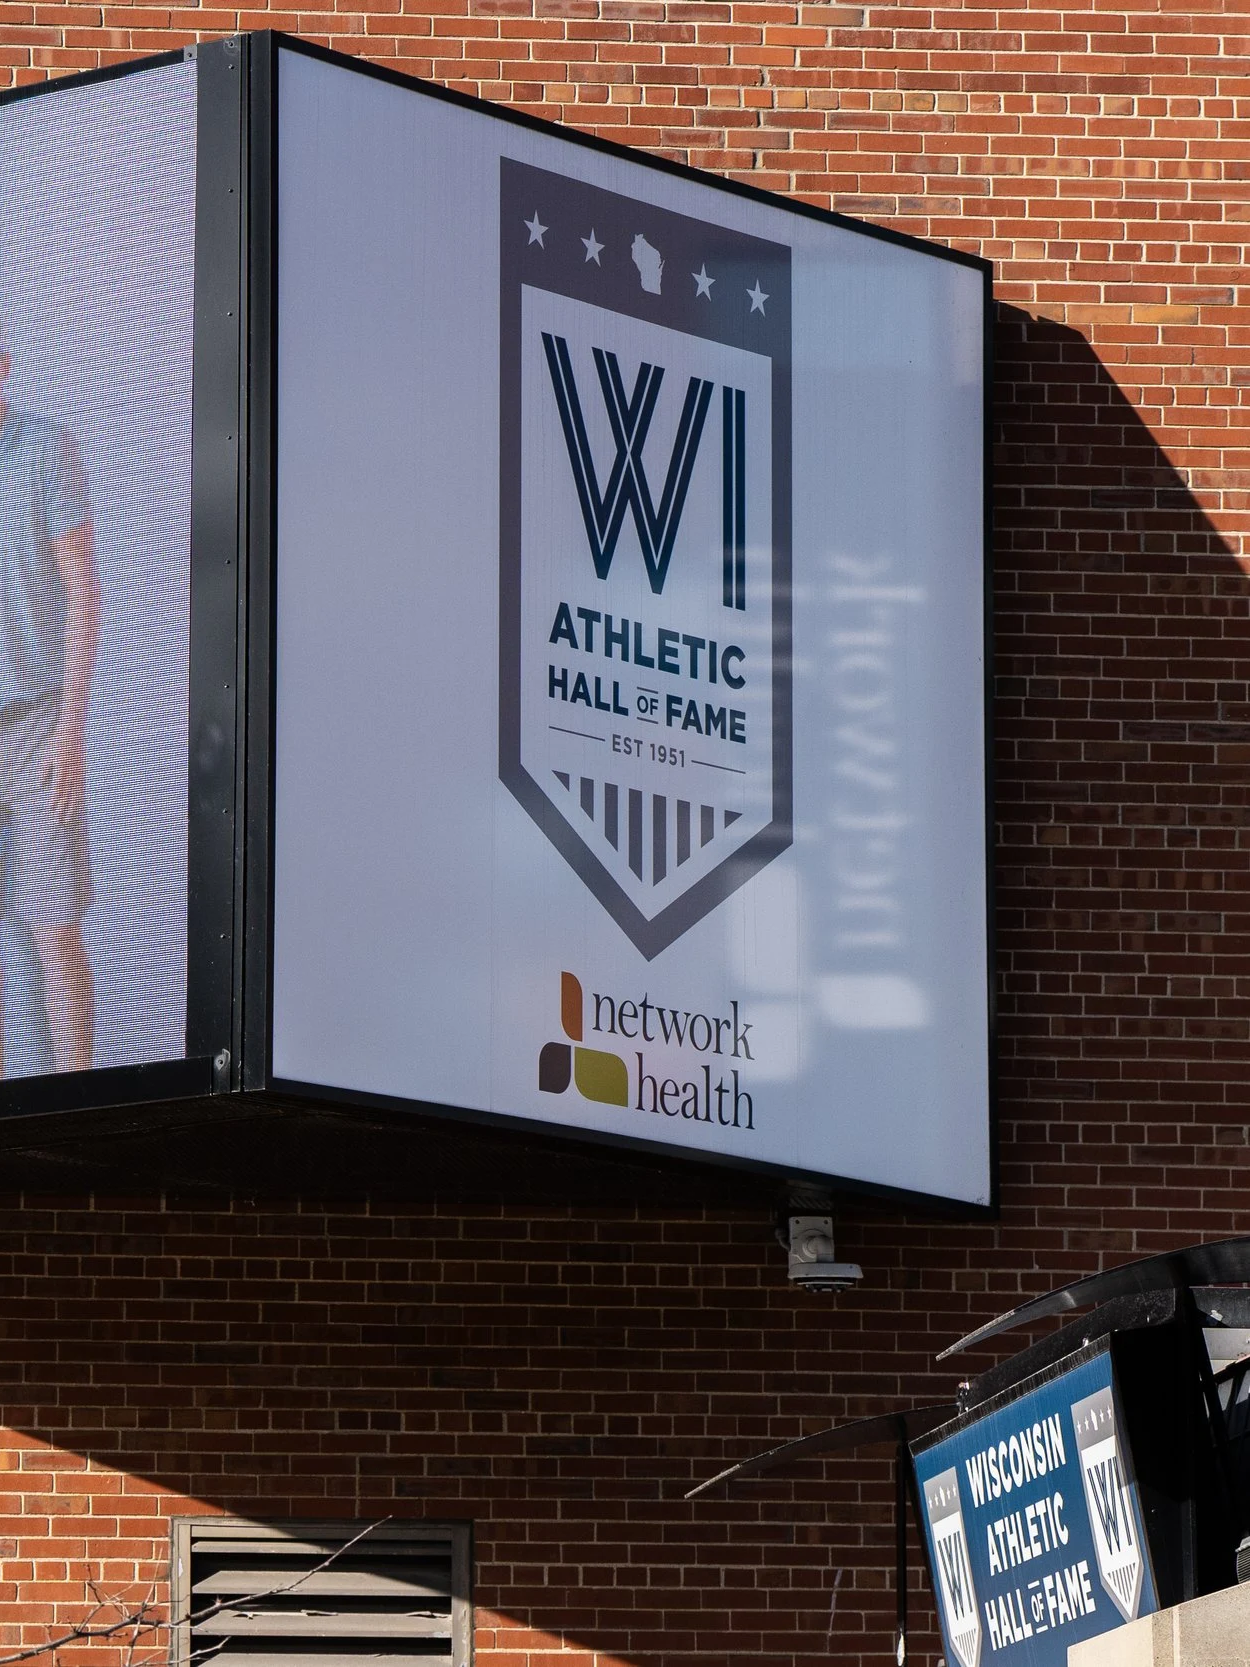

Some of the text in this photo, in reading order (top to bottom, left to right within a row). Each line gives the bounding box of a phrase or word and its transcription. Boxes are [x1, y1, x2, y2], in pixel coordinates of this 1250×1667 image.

[541, 331, 746, 612] WI
[548, 601, 746, 690] ATHLETIC
[548, 664, 746, 745] HALL OF FAME
[611, 733, 686, 768] EST 1951
[592, 992, 756, 1062] network
[634, 1051, 756, 1131] health
[965, 1413, 1066, 1508] WISCONSIN
[987, 1492, 1069, 1577] ATHLETIC
[1086, 1455, 1133, 1556] WI
[937, 1531, 974, 1621] WI
[984, 1560, 1096, 1651] HALL OF FAME
